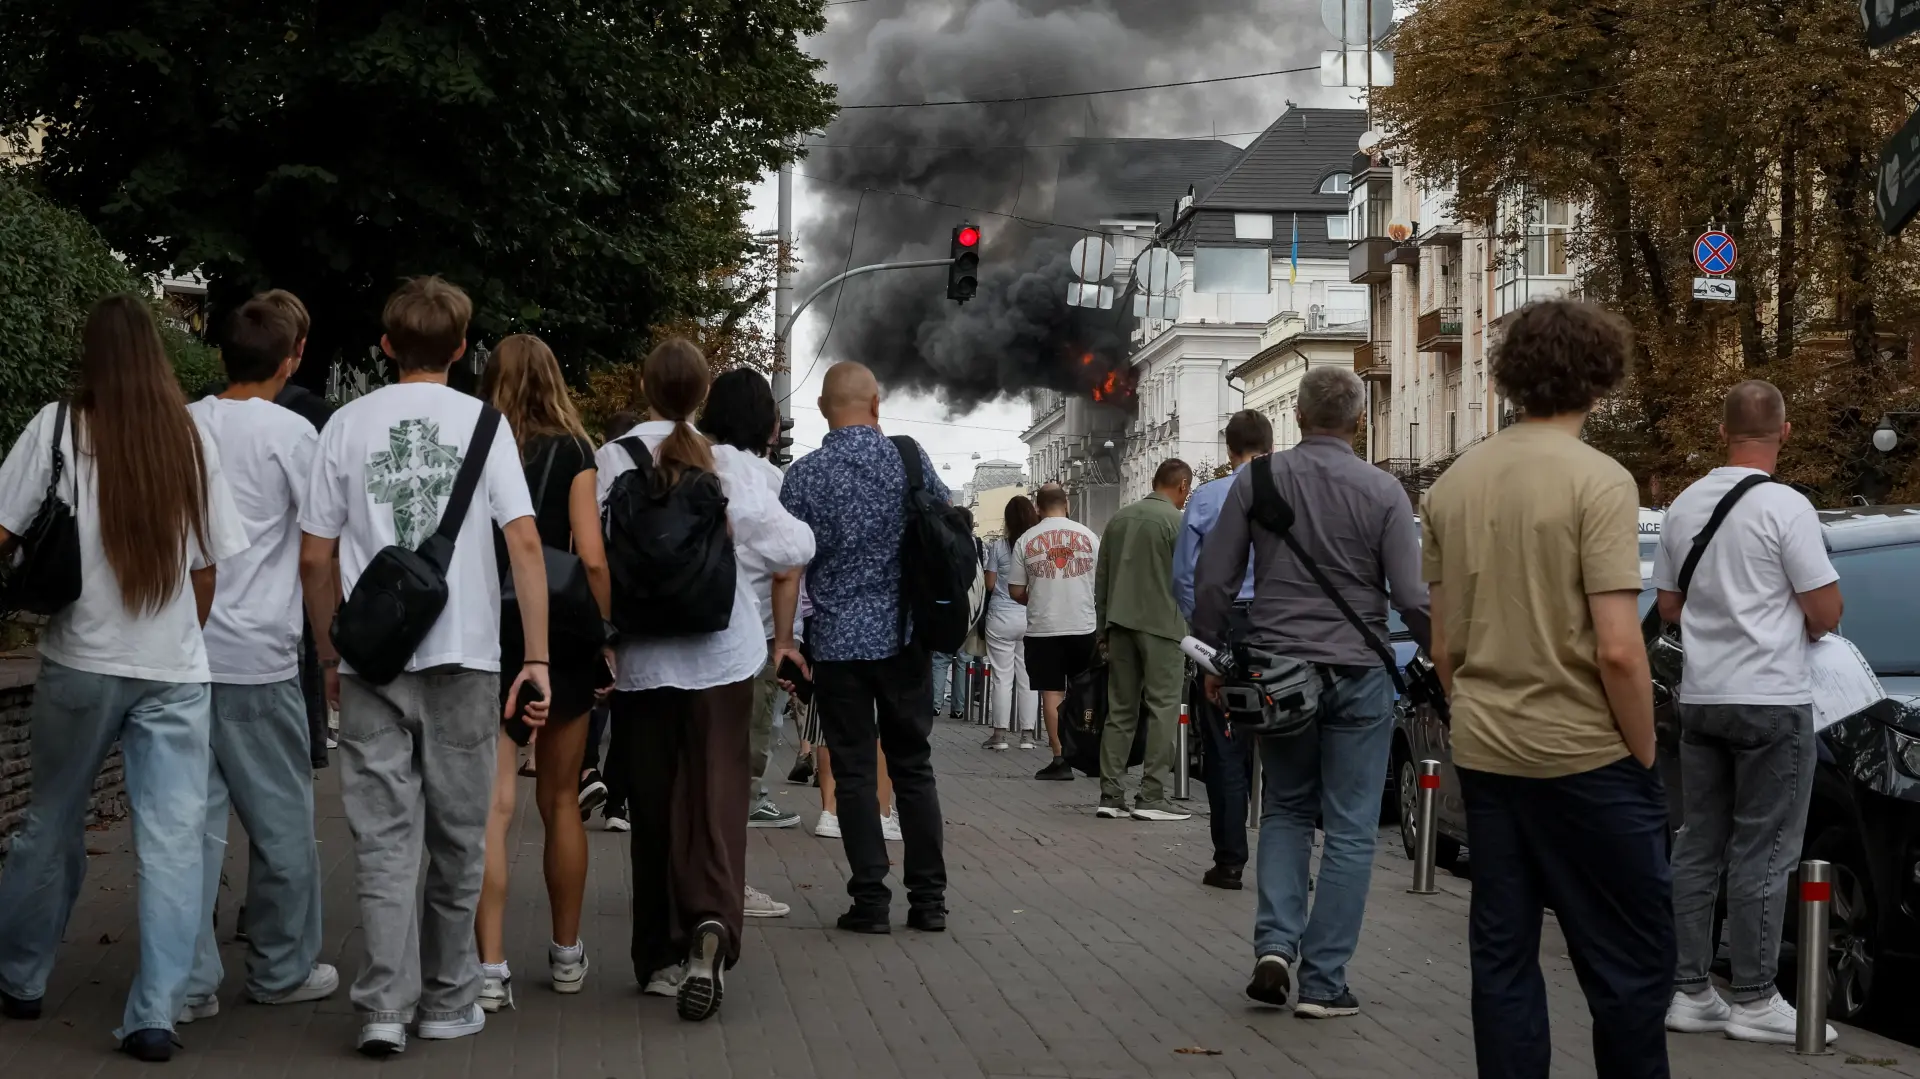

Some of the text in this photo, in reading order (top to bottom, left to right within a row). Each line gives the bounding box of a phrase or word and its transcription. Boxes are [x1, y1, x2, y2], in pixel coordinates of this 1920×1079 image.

[1638, 522, 1661, 532] NCE
[1025, 529, 1093, 558] KNICKS
[1026, 558, 1093, 579] NEW YORK
